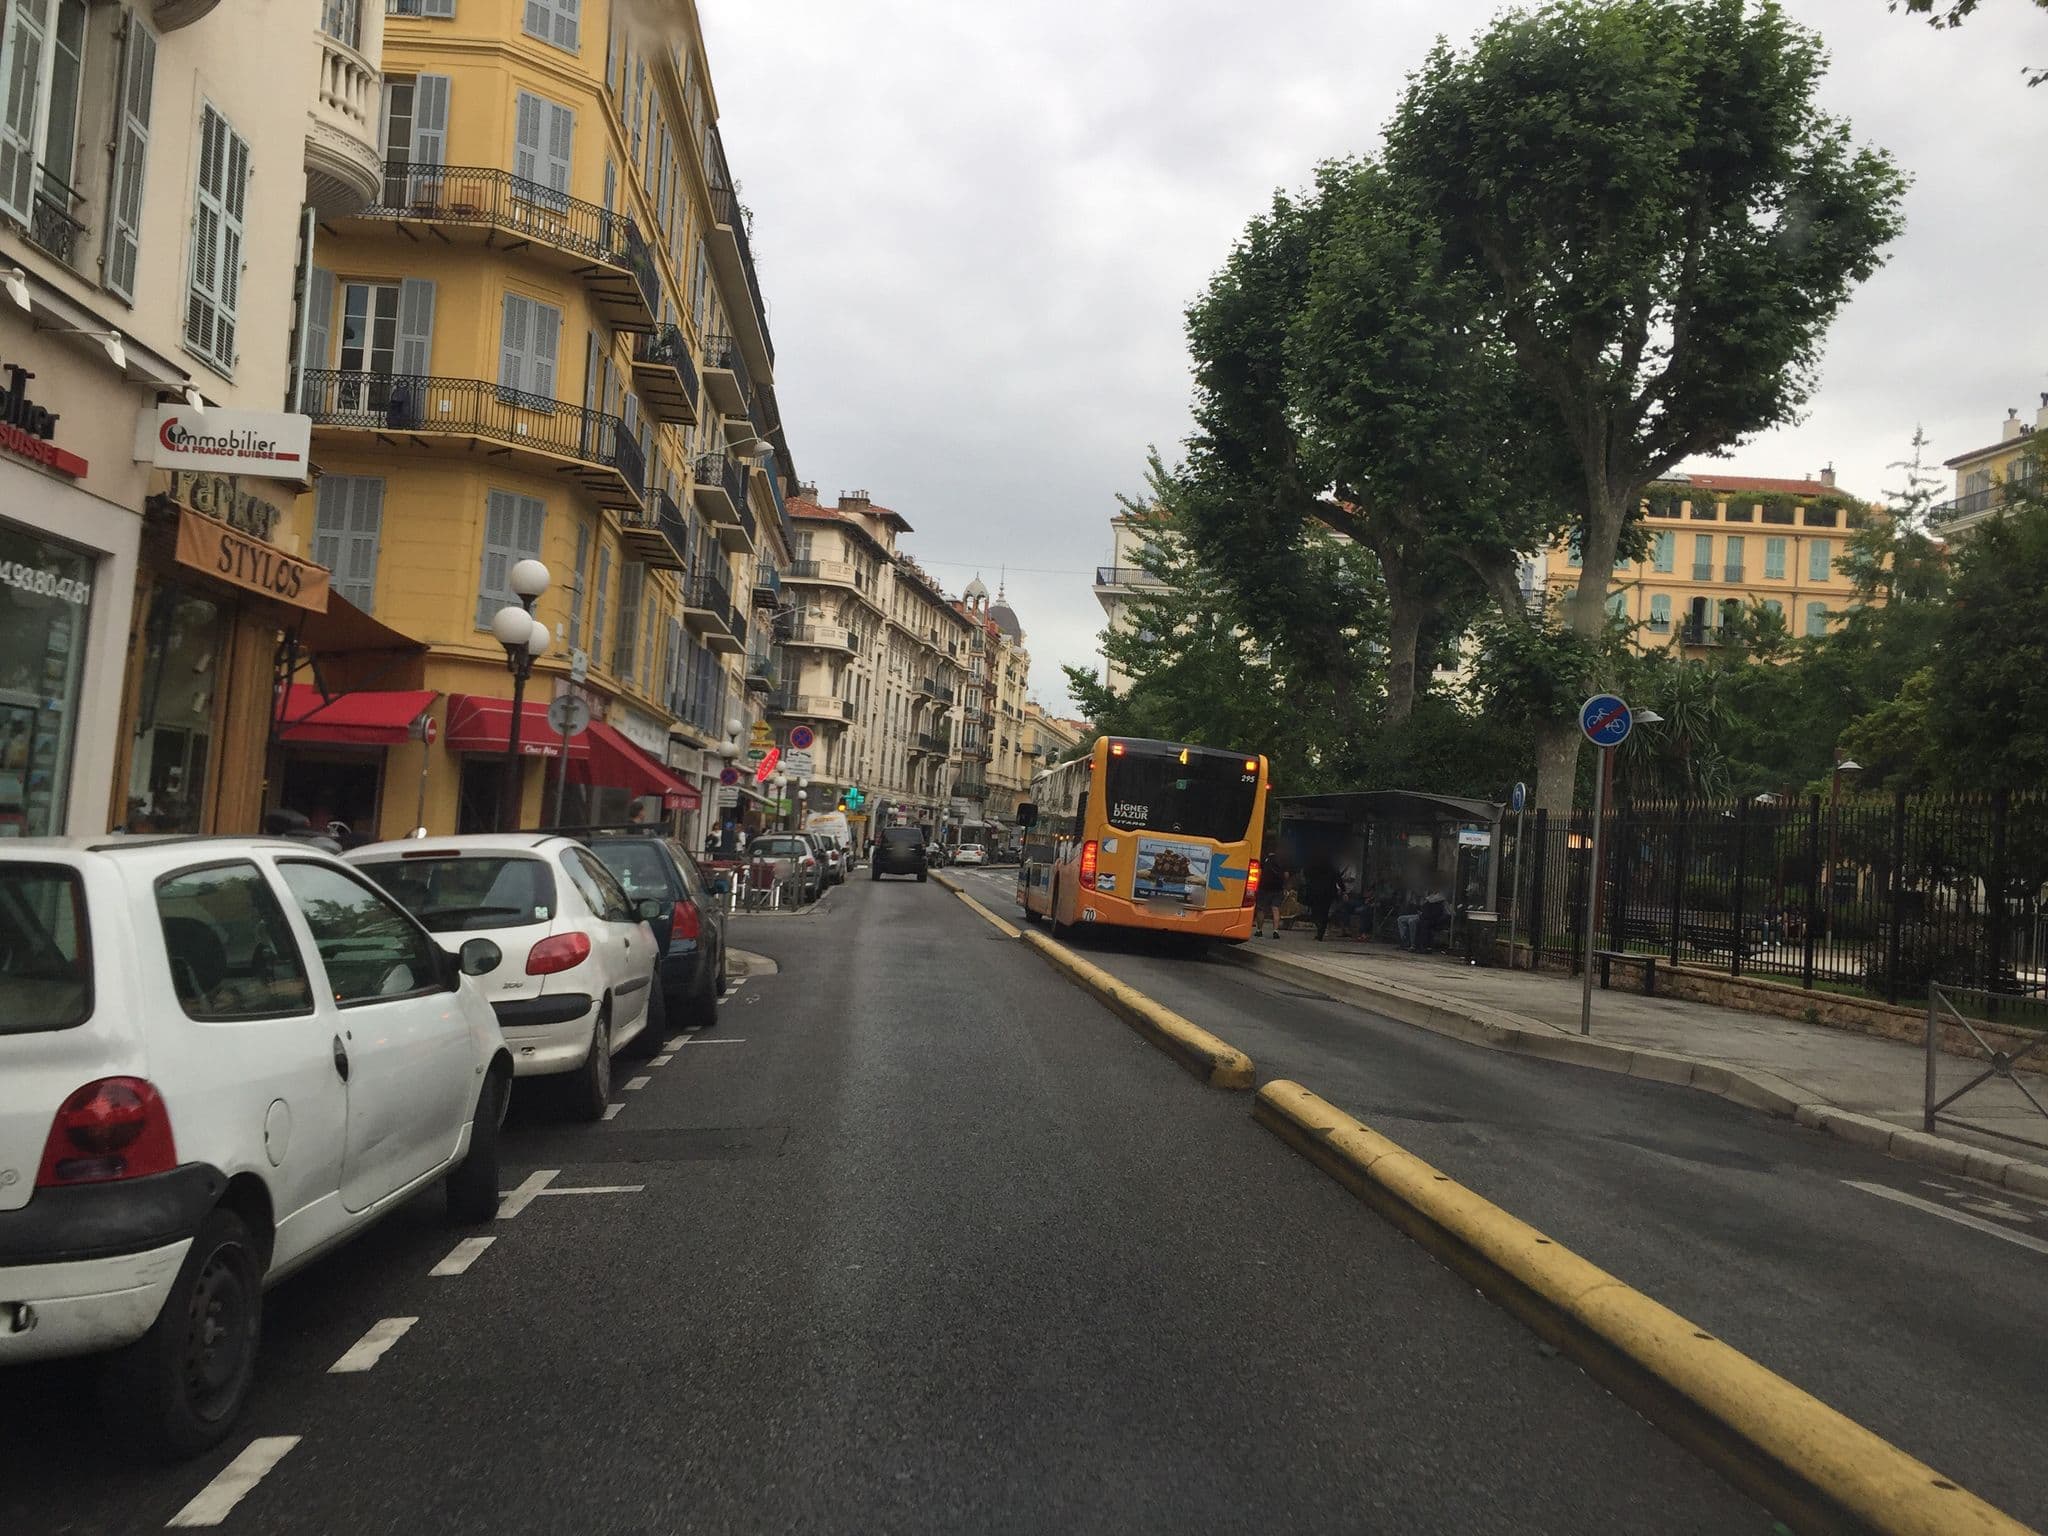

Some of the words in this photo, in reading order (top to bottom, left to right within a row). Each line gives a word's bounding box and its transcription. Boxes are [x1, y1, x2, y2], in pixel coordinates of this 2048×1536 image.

[176, 445, 190, 453] LA
[192, 446, 235, 457] FRANCO
[237, 450, 275, 460] SUISSE
[217, 534, 304, 599] STYLOS
[1179, 748, 1189, 765] 4
[1241, 774, 1256, 783] 295
[1085, 909, 1095, 920] 70
